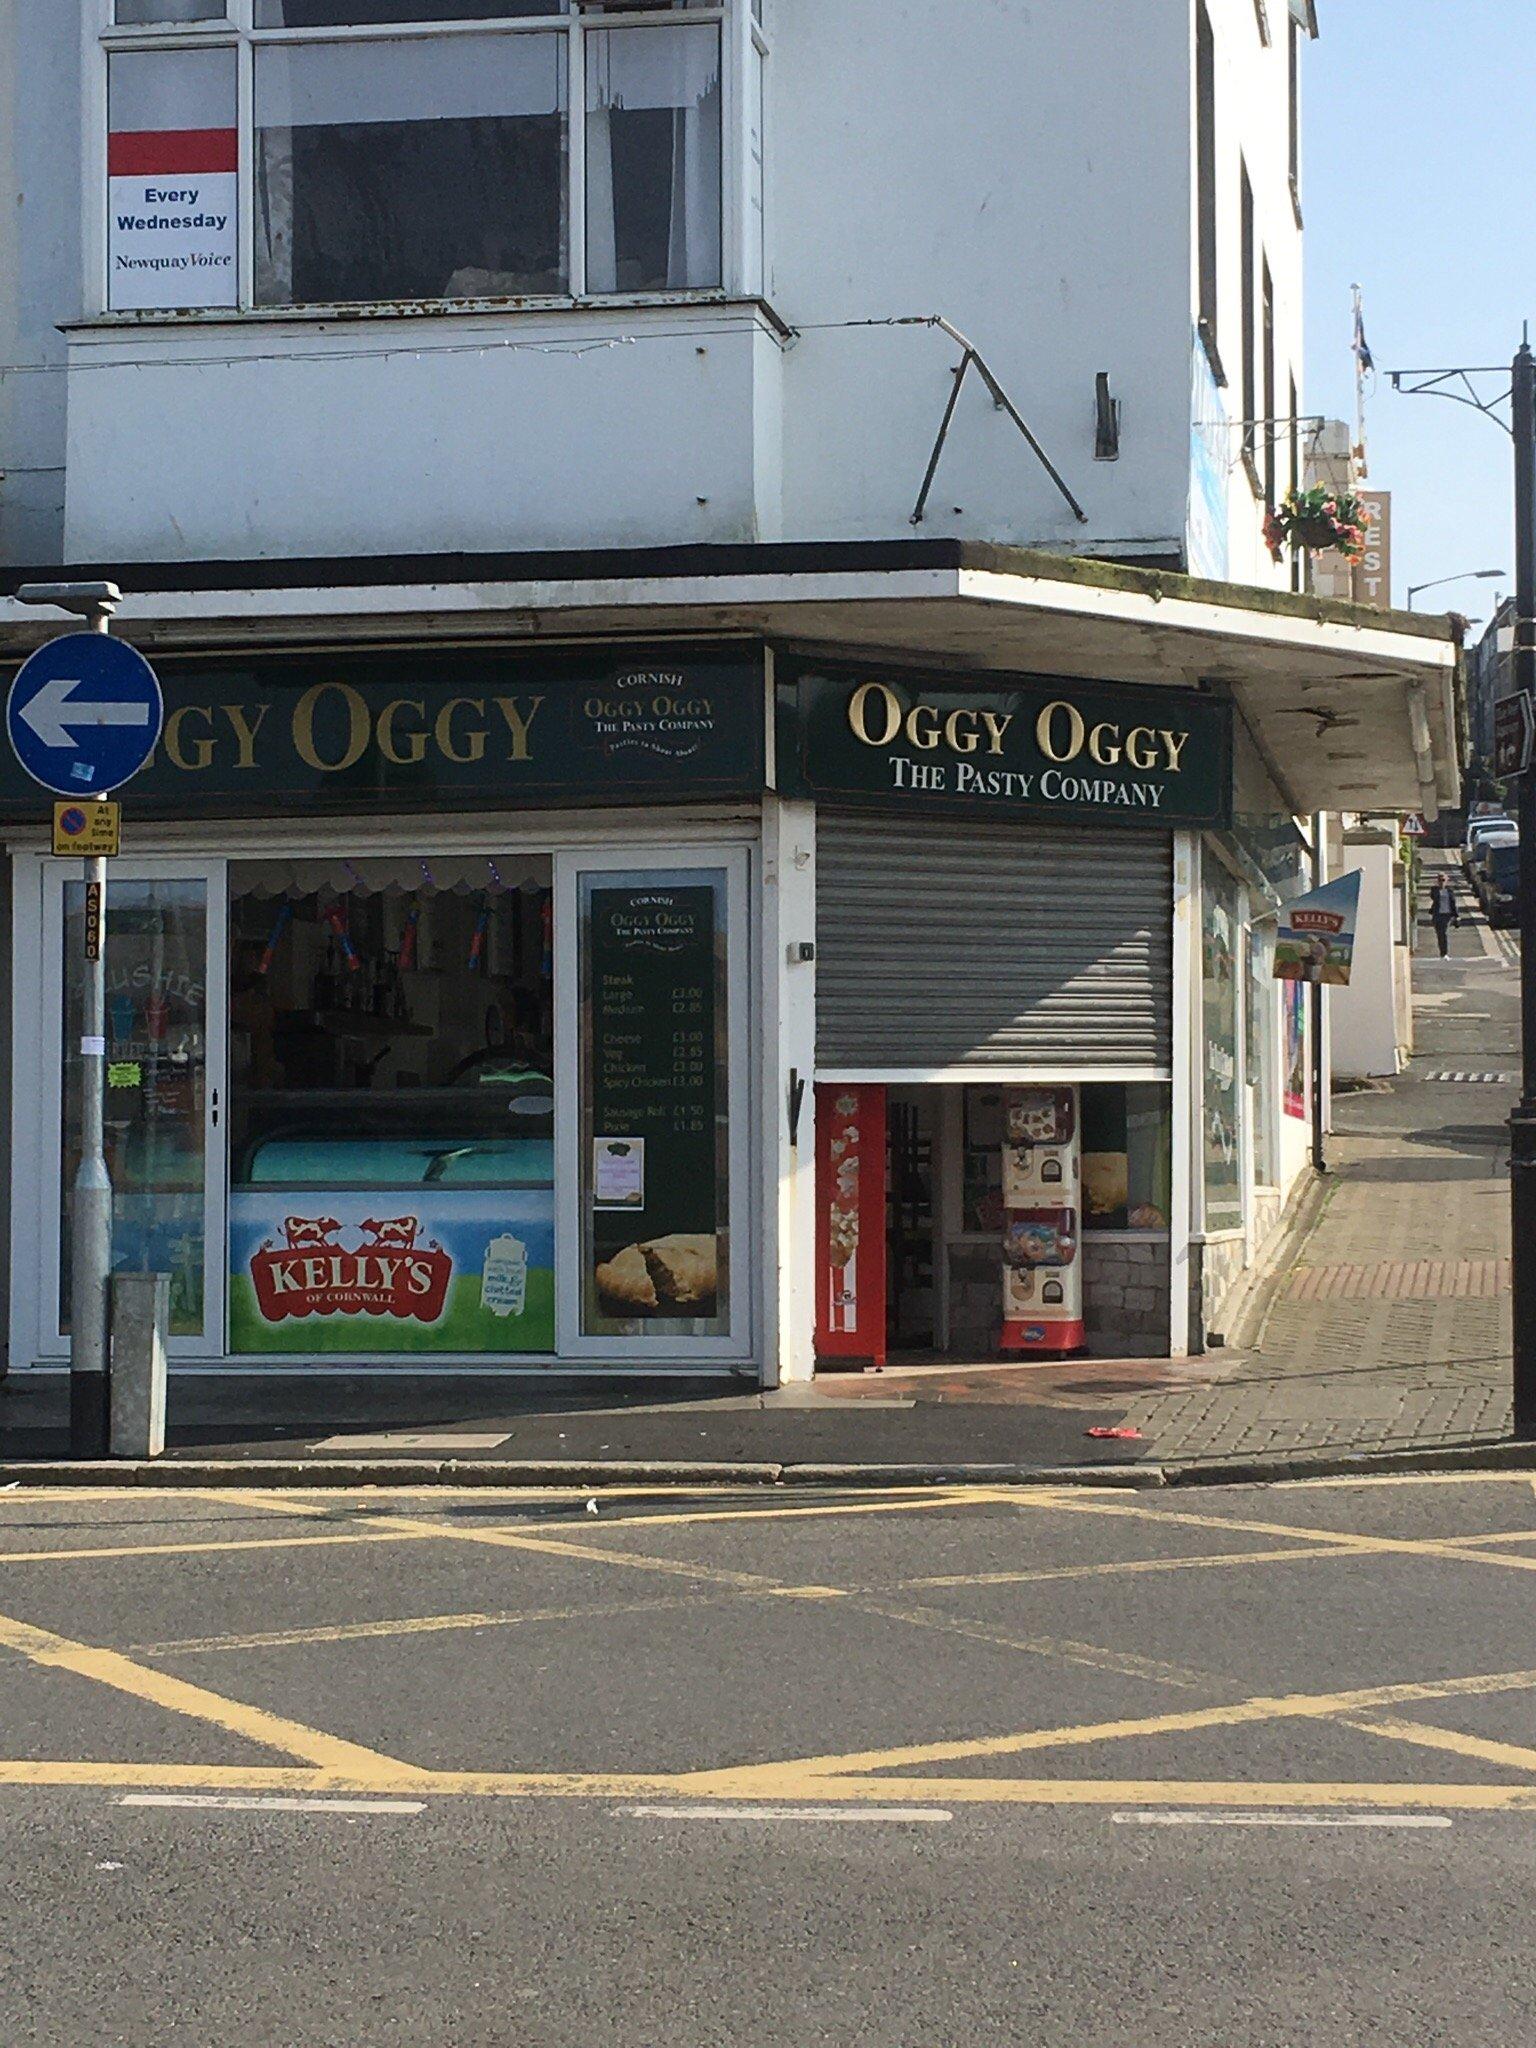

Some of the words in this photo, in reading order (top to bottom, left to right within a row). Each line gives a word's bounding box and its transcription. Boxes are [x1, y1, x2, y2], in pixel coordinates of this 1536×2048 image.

[144, 188, 199, 205] Every
[117, 213, 227, 230] Wednesday
[1363, 501, 1382, 607] REST
[617, 673, 683, 688] CORNISH
[141, 703, 270, 770] GY
[292, 682, 546, 771] OGGY
[659, 718, 715, 731] COMPANY
[849, 681, 1012, 755] OGGY
[1036, 701, 1189, 772] OGGY
[889, 757, 945, 791] THE
[956, 763, 1033, 797] PASTY
[1040, 769, 1165, 807] COMPANY
[97, 805, 109, 815] At
[94, 818, 112, 827] any
[91, 828, 114, 837] time
[86, 884, 99, 958] AS060
[269, 1256, 433, 1295] KELLY'S
[306, 1293, 322, 1303] OF
[326, 1292, 396, 1304] CORNWALL
